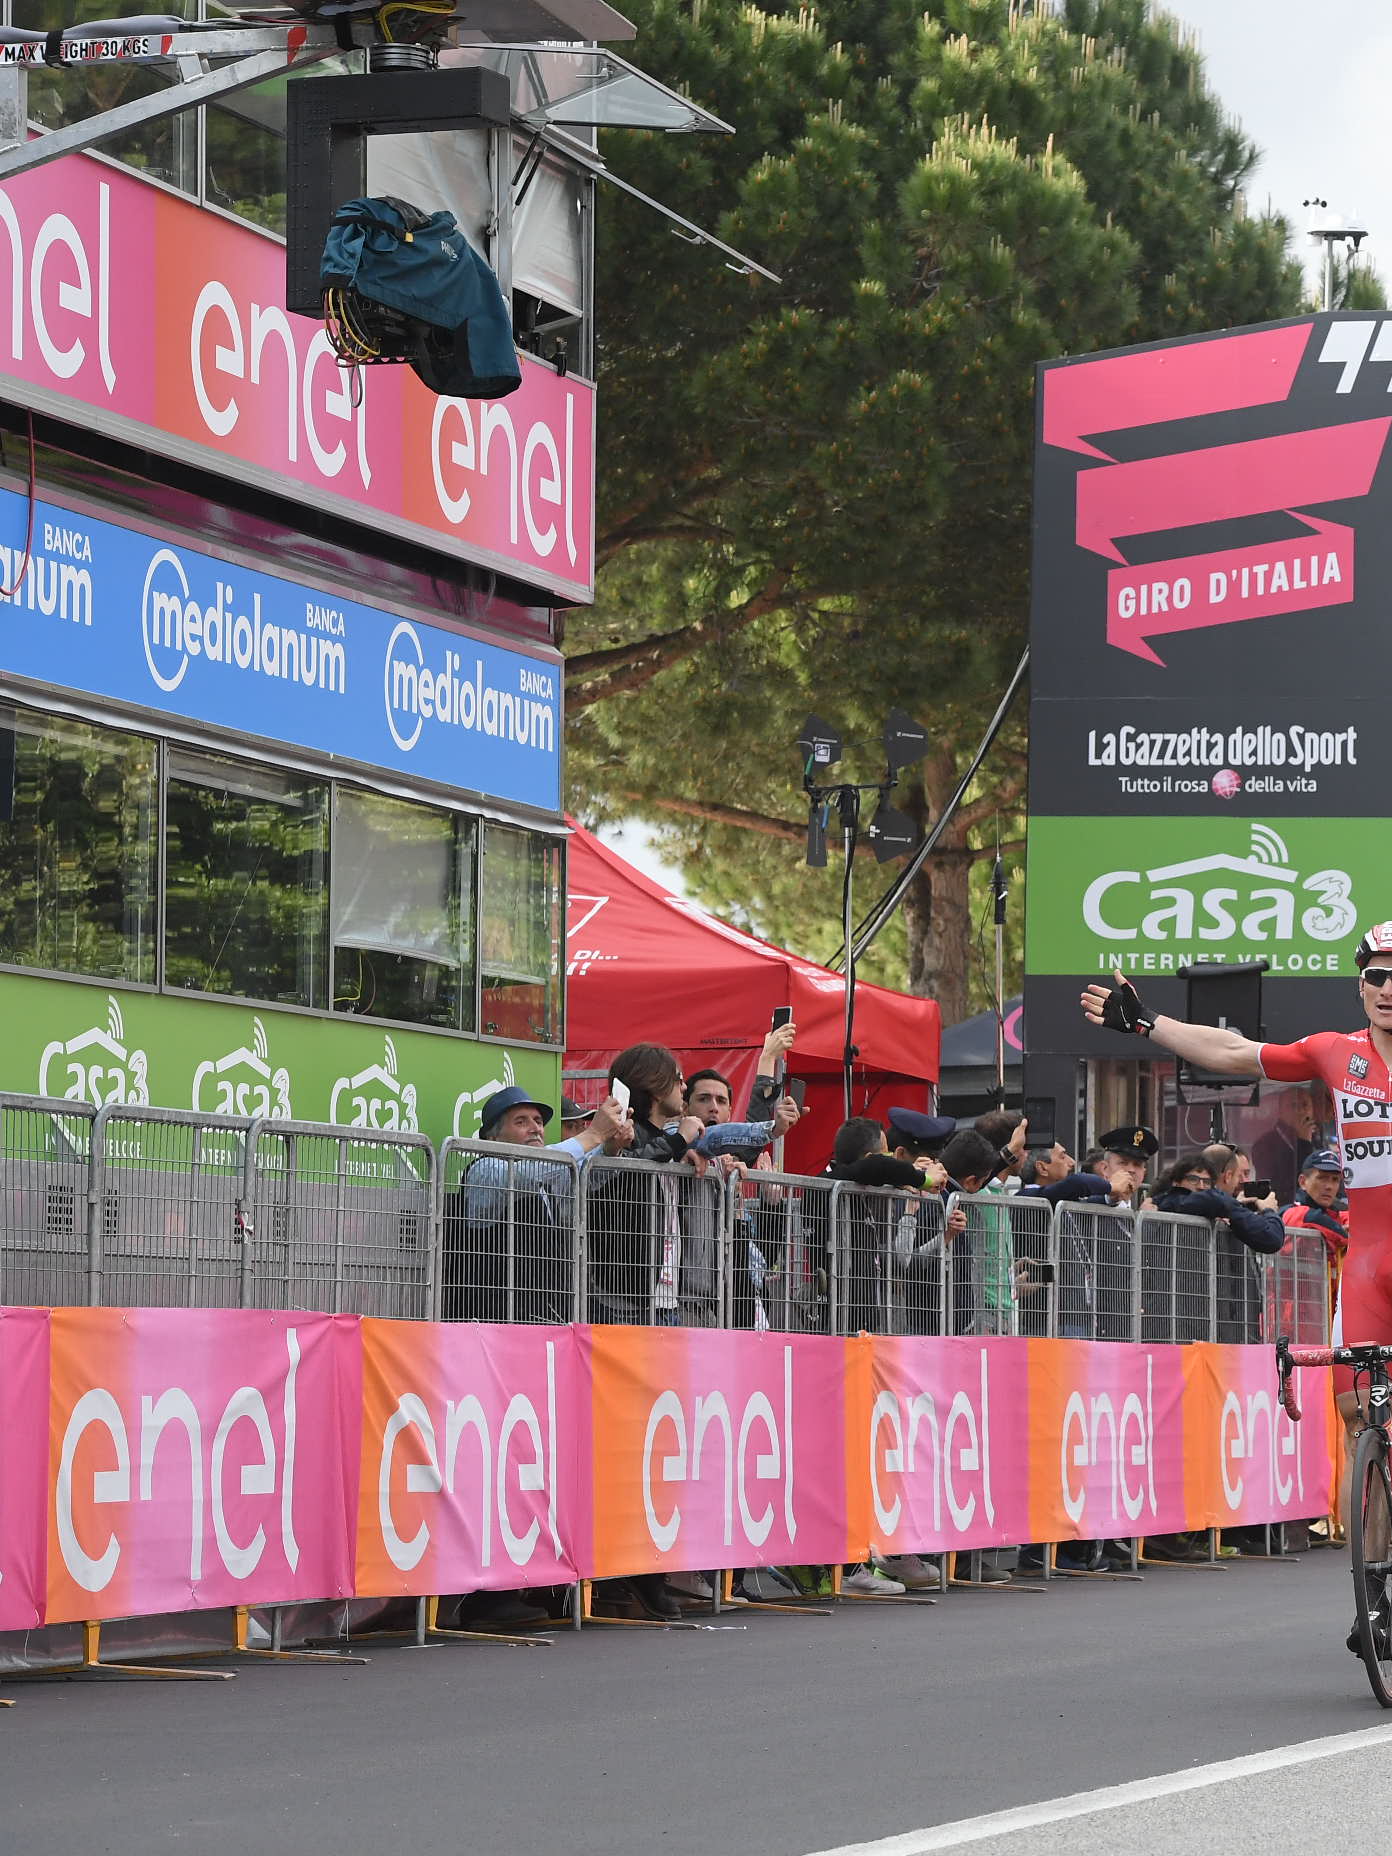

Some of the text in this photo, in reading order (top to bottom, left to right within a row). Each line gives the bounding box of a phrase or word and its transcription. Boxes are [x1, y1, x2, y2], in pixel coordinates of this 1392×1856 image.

[5, 46, 36, 62] MAX
[102, 40, 117, 56] 30
[122, 38, 148, 55] KGS
[431, 392, 577, 567] enel
[43, 524, 92, 563] BANCA
[1118, 552, 1342, 618] GIRO D'ITALIA
[152, 583, 345, 694] mediolanum
[306, 603, 345, 637] BANCA
[393, 651, 553, 752] mediolanum
[520, 669, 553, 700] BANCA
[1088, 725, 1357, 772] La Gazzetta dello Sport
[1118, 776, 1317, 793] Tutto il rosa della vita
[1083, 869, 1357, 941] Casa3
[1352, 1081, 1386, 1100] Gazzetta
[56, 1328, 300, 1592] enel
[379, 1341, 562, 1570] enel
[643, 1345, 796, 1552] enel
[870, 1348, 994, 1537] enel
[1062, 1355, 1157, 1522] enel
[1220, 1366, 1304, 1510] enel
